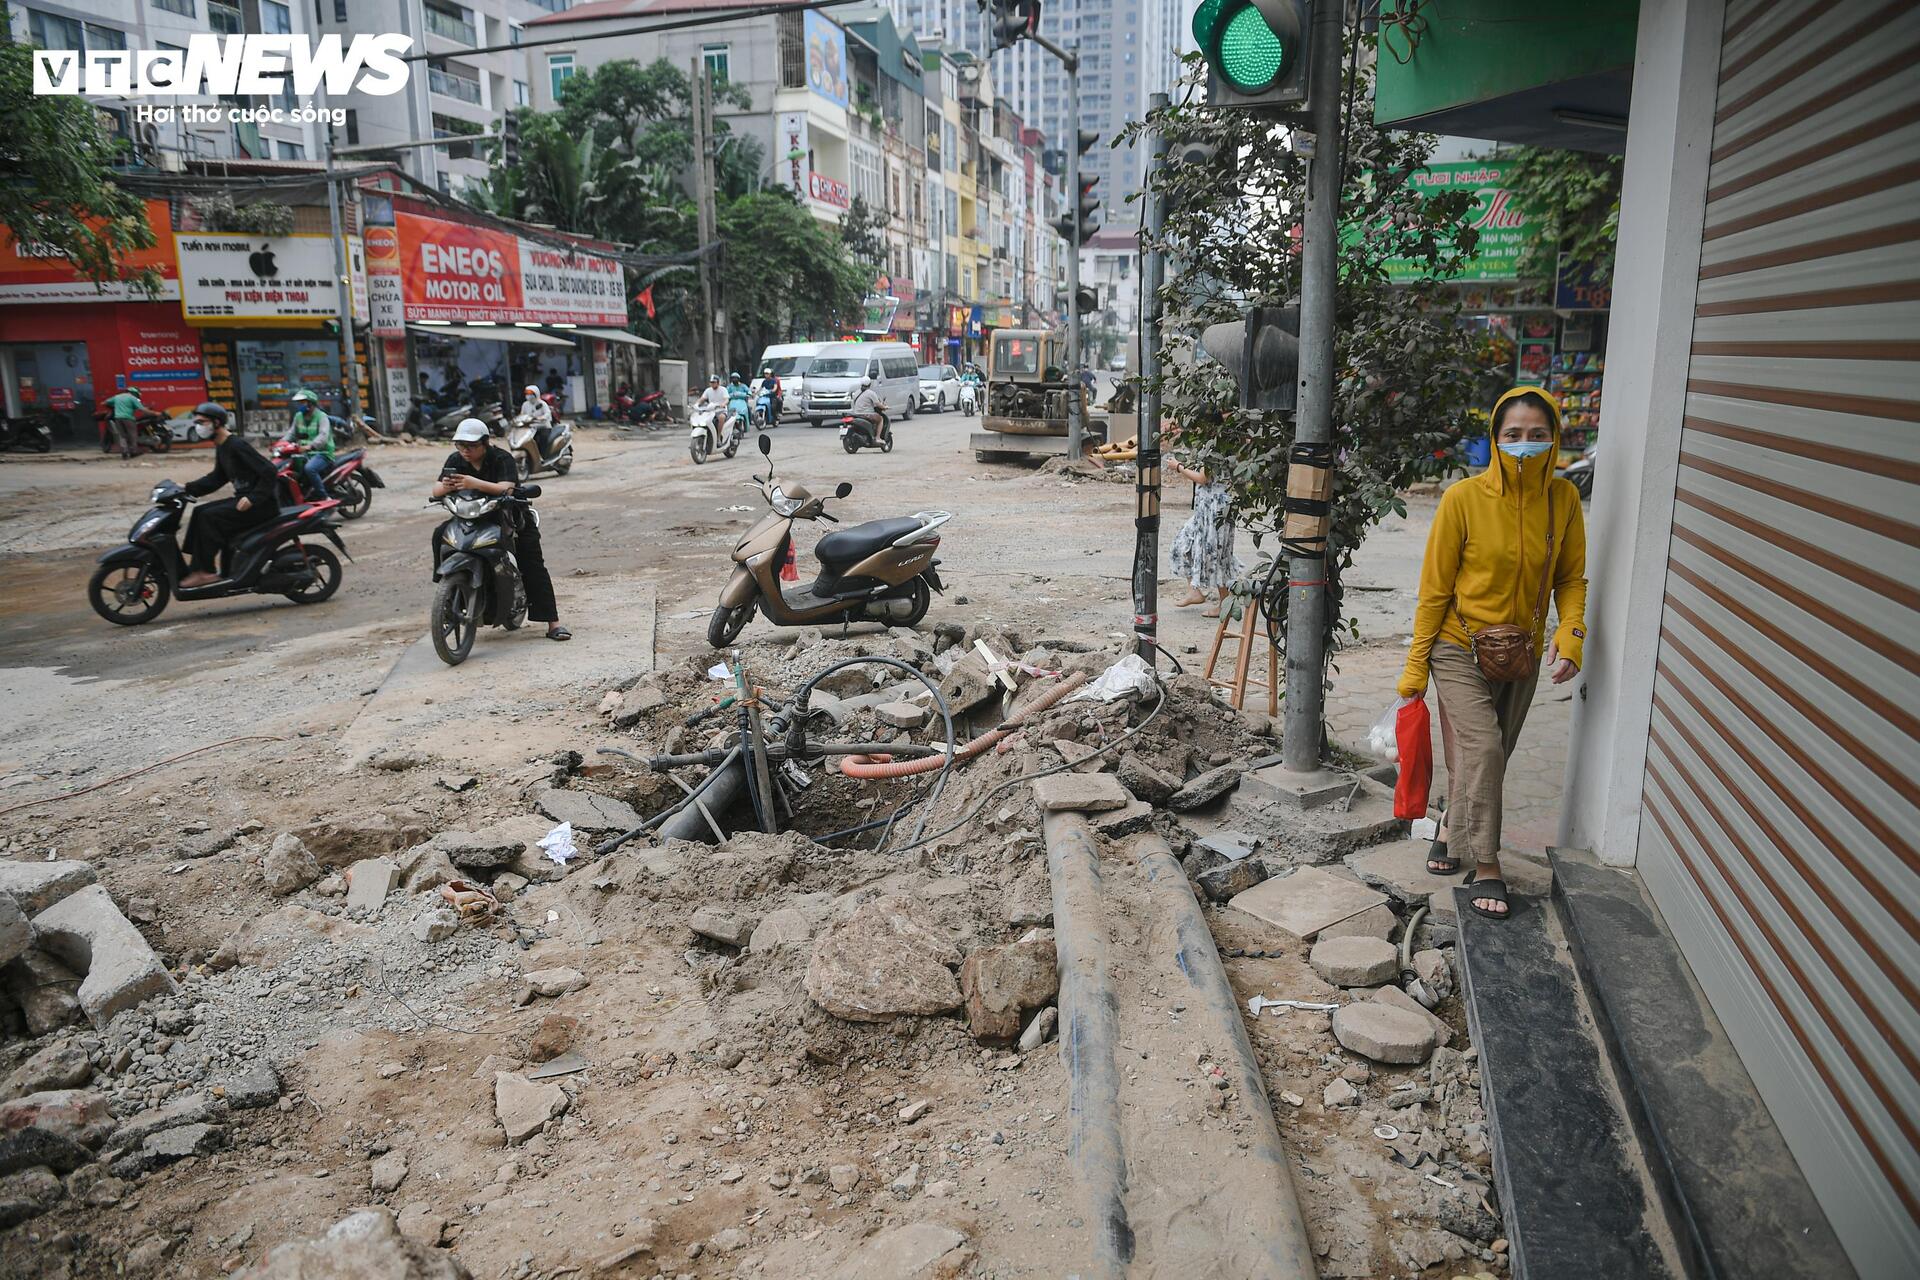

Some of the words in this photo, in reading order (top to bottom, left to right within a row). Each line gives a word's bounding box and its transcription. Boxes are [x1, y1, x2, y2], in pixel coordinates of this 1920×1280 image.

[1455, 168, 1500, 184] NHẬP
[421, 243, 504, 279] ENEOS
[426, 279, 480, 300] MOTOR
[483, 283, 505, 302] OIL
[381, 305, 393, 314] XE
[128, 344, 158, 354] THÊM
[176, 344, 195, 355] HỘI
[128, 356, 158, 366] CỘNG
[160, 356, 175, 365] AN
[176, 355, 199, 364] TÂM
